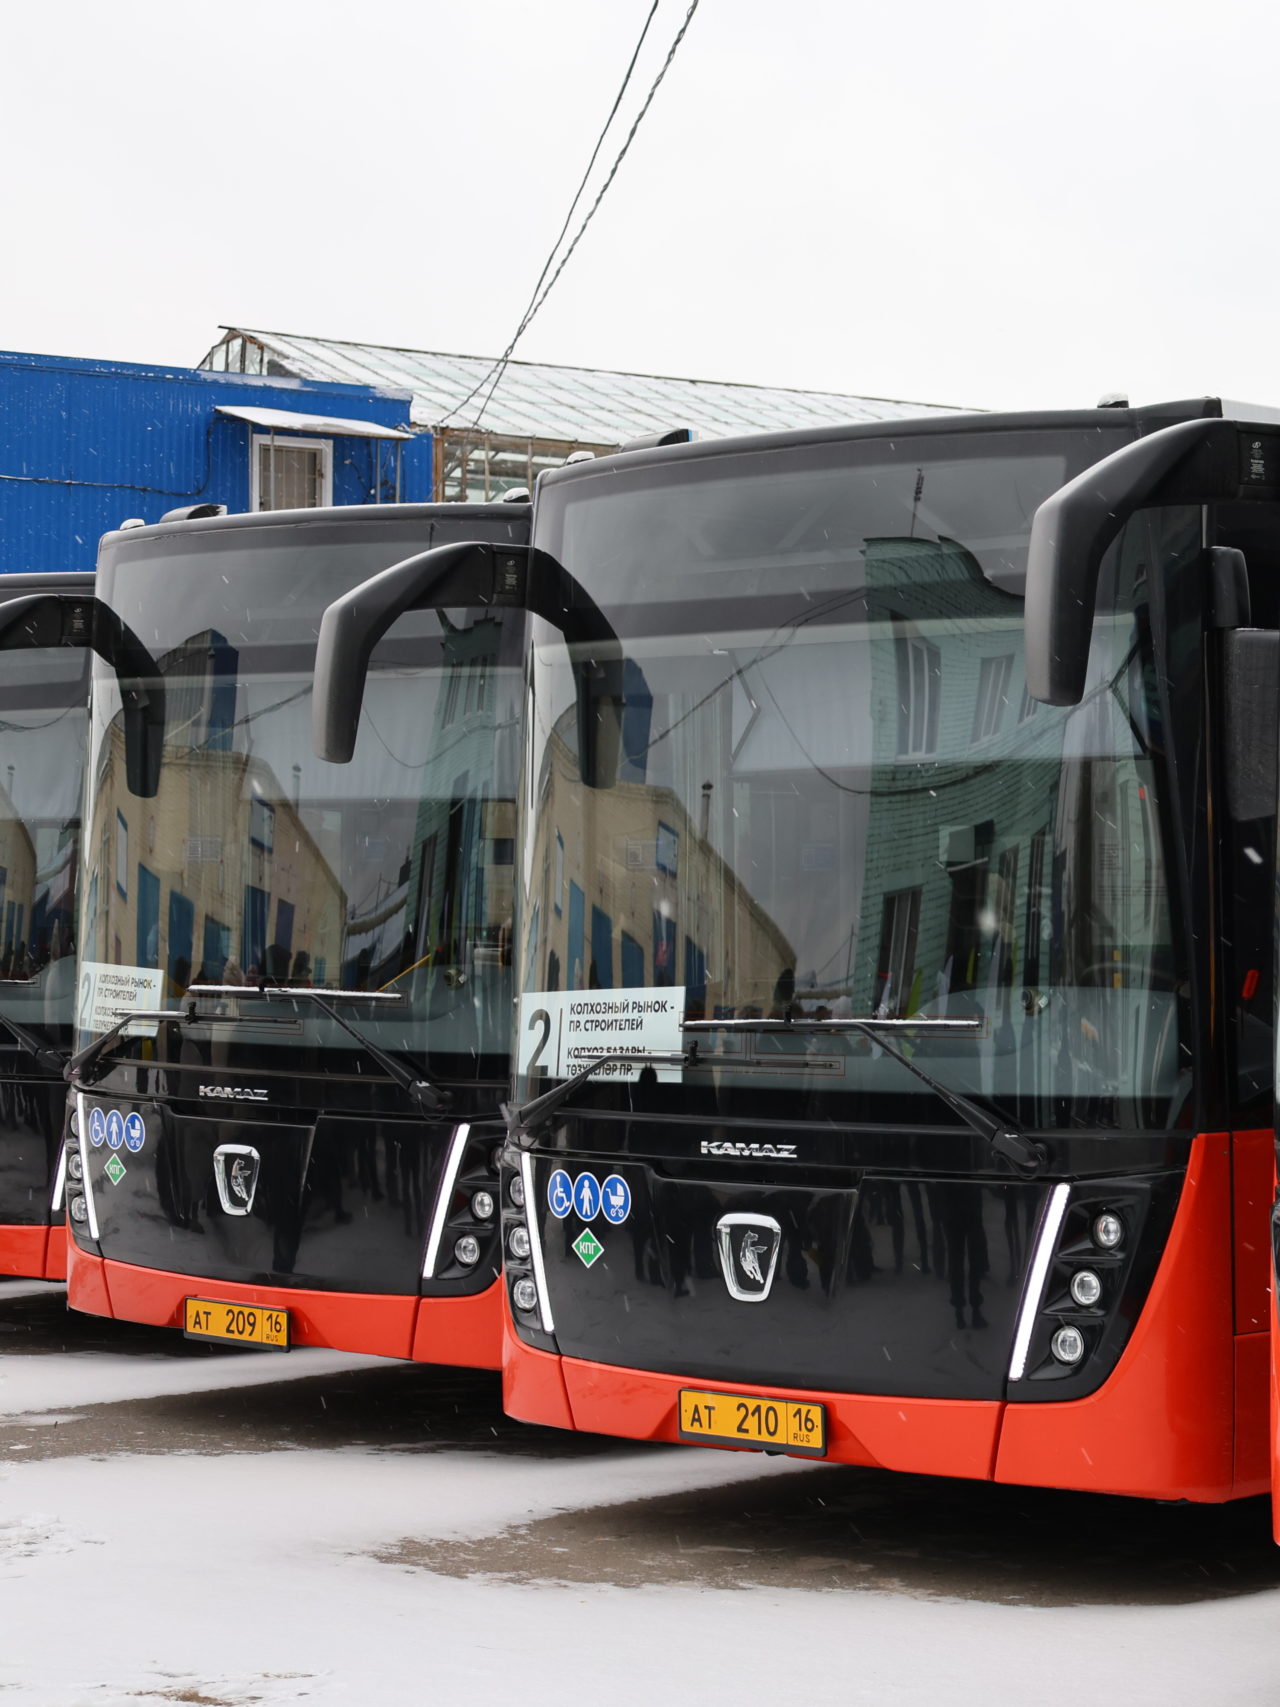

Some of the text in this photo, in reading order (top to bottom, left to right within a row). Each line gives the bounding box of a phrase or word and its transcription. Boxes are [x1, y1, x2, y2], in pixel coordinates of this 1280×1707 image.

[80, 972, 91, 1027] 2
[570, 999, 629, 1016] КОЛХОЗНЫЙ
[631, 1000, 668, 1015] РЫНОК
[569, 1016, 643, 1033] ПР. СТРОИТЕЛЕЙ
[528, 1008, 551, 1077] 2
[619, 1064, 634, 1076] ПР.
[198, 1085, 269, 1101] KAMAZ
[700, 1140, 798, 1158] KAMAZ
[579, 1241, 597, 1255] КПГ
[225, 1309, 257, 1337] 209
[266, 1313, 282, 1333] 16
[265, 1333, 279, 1342] RUS
[736, 1402, 779, 1437] 210
[792, 1407, 815, 1433] 16
[793, 1432, 811, 1444] RUS
